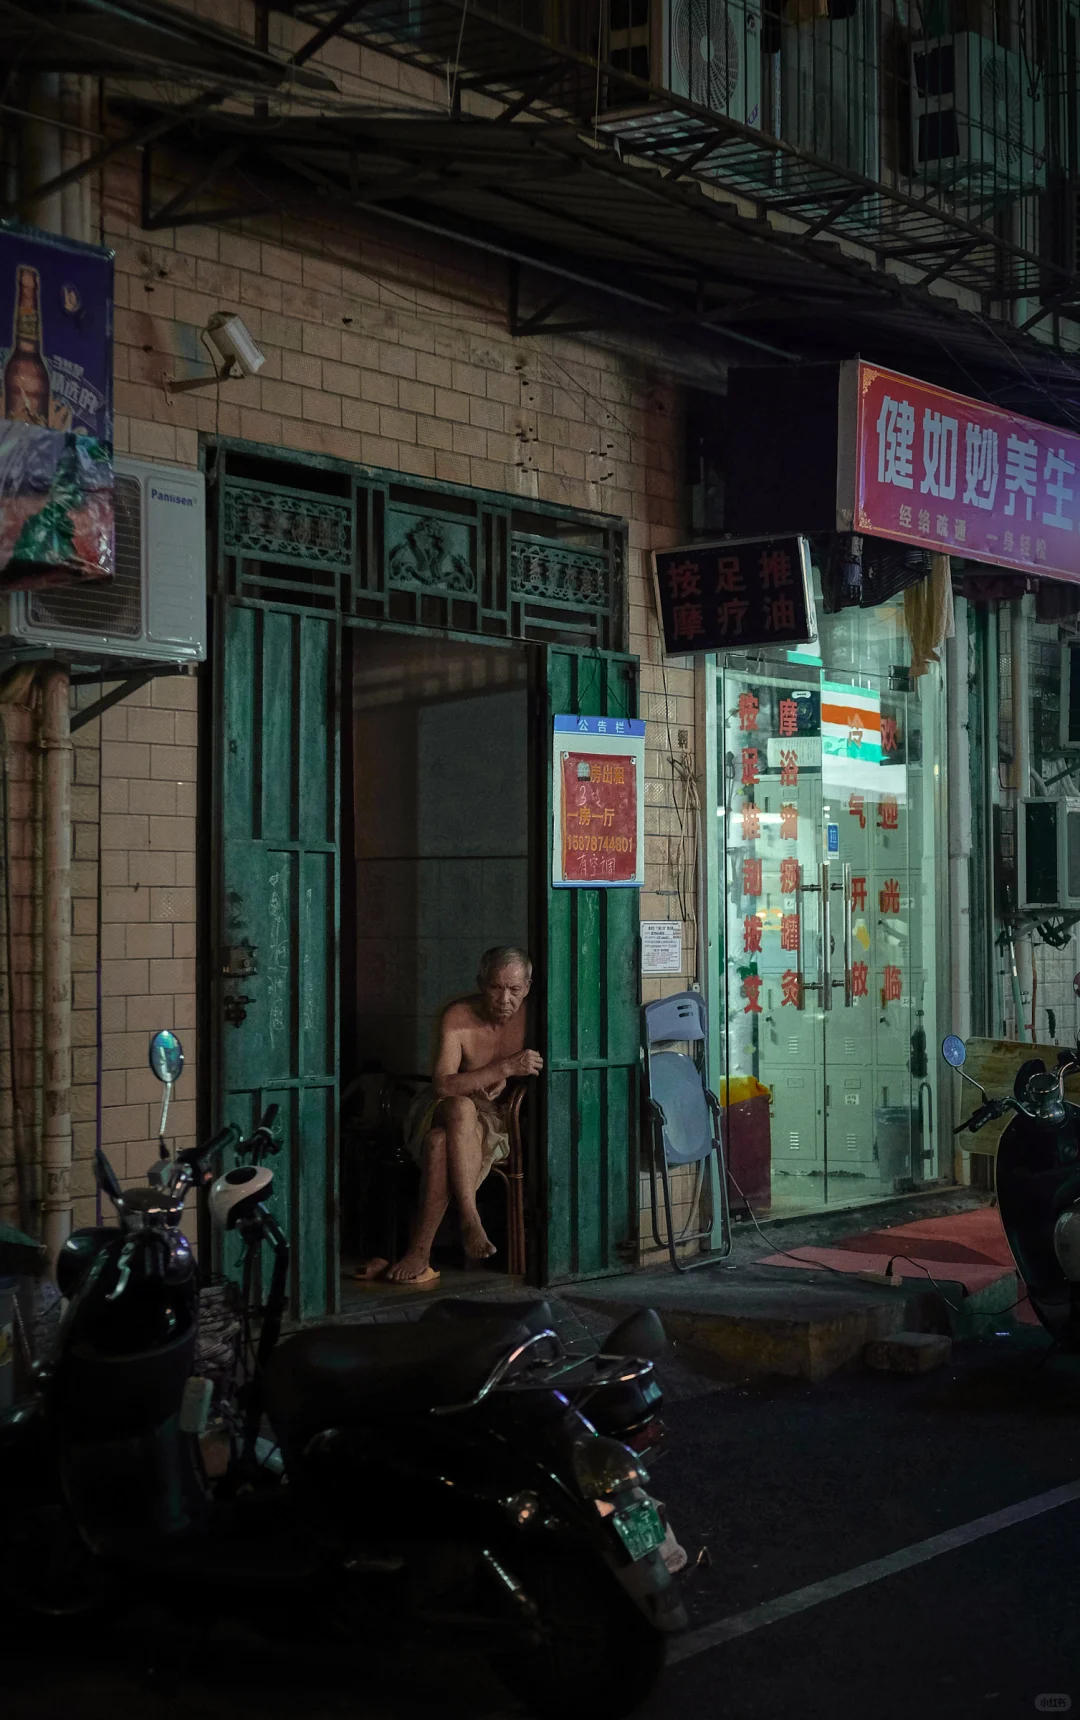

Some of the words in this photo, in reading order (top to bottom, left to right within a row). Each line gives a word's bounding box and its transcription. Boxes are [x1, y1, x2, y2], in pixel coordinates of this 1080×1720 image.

[877, 396, 1080, 531] 健如妙养生
[899, 504, 967, 542] 经络疏通
[986, 530, 1047, 560] 一身轻松
[666, 560, 705, 641] 按摩
[715, 556, 749, 636] 足疗
[759, 550, 795, 631] 推油
[579, 719, 625, 734] 公告栏
[738, 691, 798, 737] 按摩
[741, 747, 798, 787] 足浴
[567, 806, 615, 828] 一房一厅
[741, 802, 798, 841] 推油
[577, 853, 616, 877] 有空调
[743, 856, 800, 897] 刮痧
[847, 712, 868, 997] 冷气开放
[879, 717, 903, 1001] 欢迎光临
[743, 914, 800, 953] 拔罐
[743, 968, 800, 1014] 艾灸
